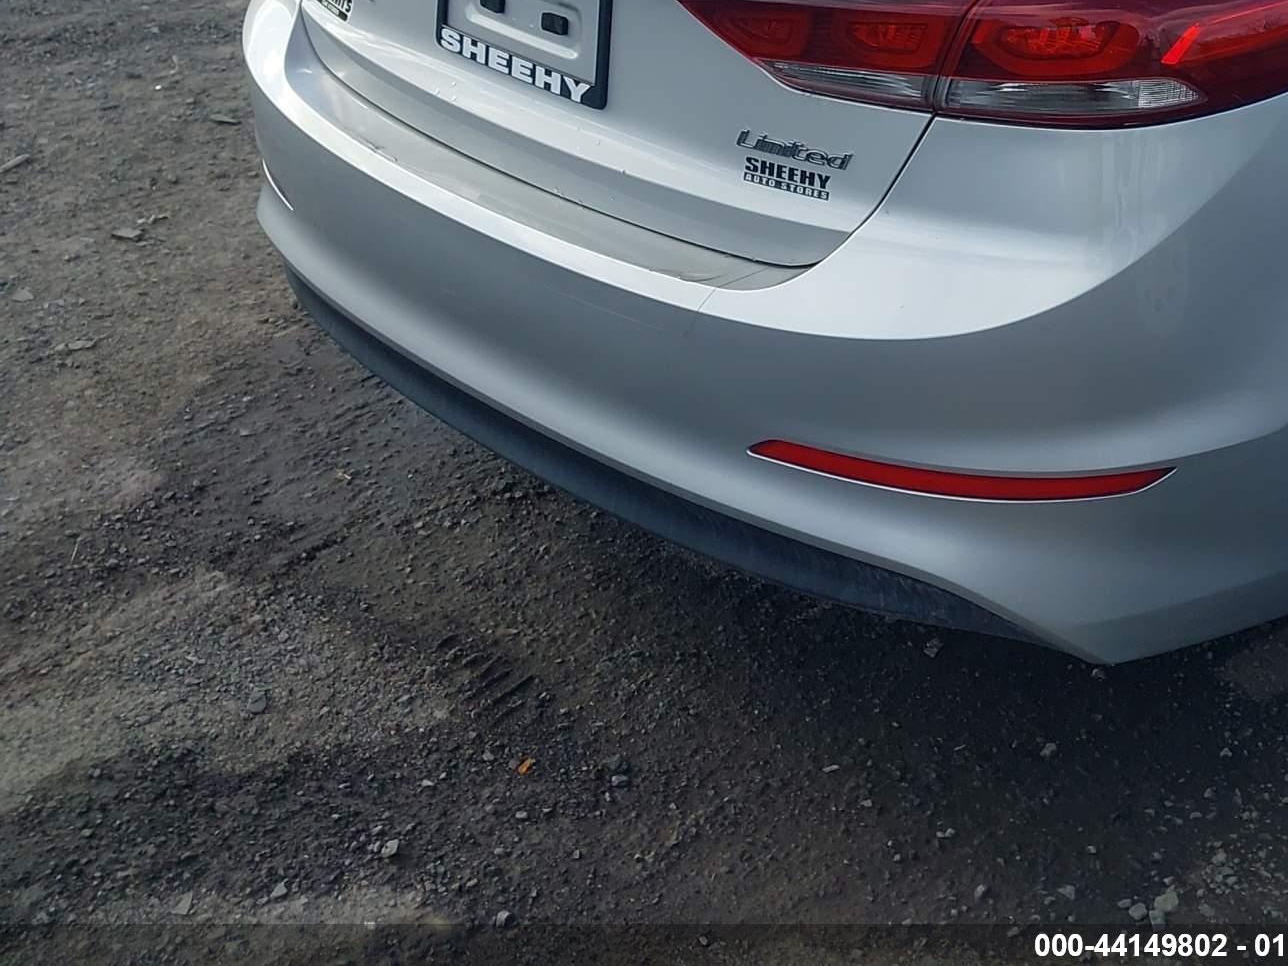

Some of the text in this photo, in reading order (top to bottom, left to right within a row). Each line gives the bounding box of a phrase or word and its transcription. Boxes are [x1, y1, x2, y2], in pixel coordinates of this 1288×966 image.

[440, 26, 592, 103] SHEEHY
[736, 129, 854, 170] Limited
[745, 156, 831, 189] SHEEHY
[745, 173, 829, 200] AUTO STORES
